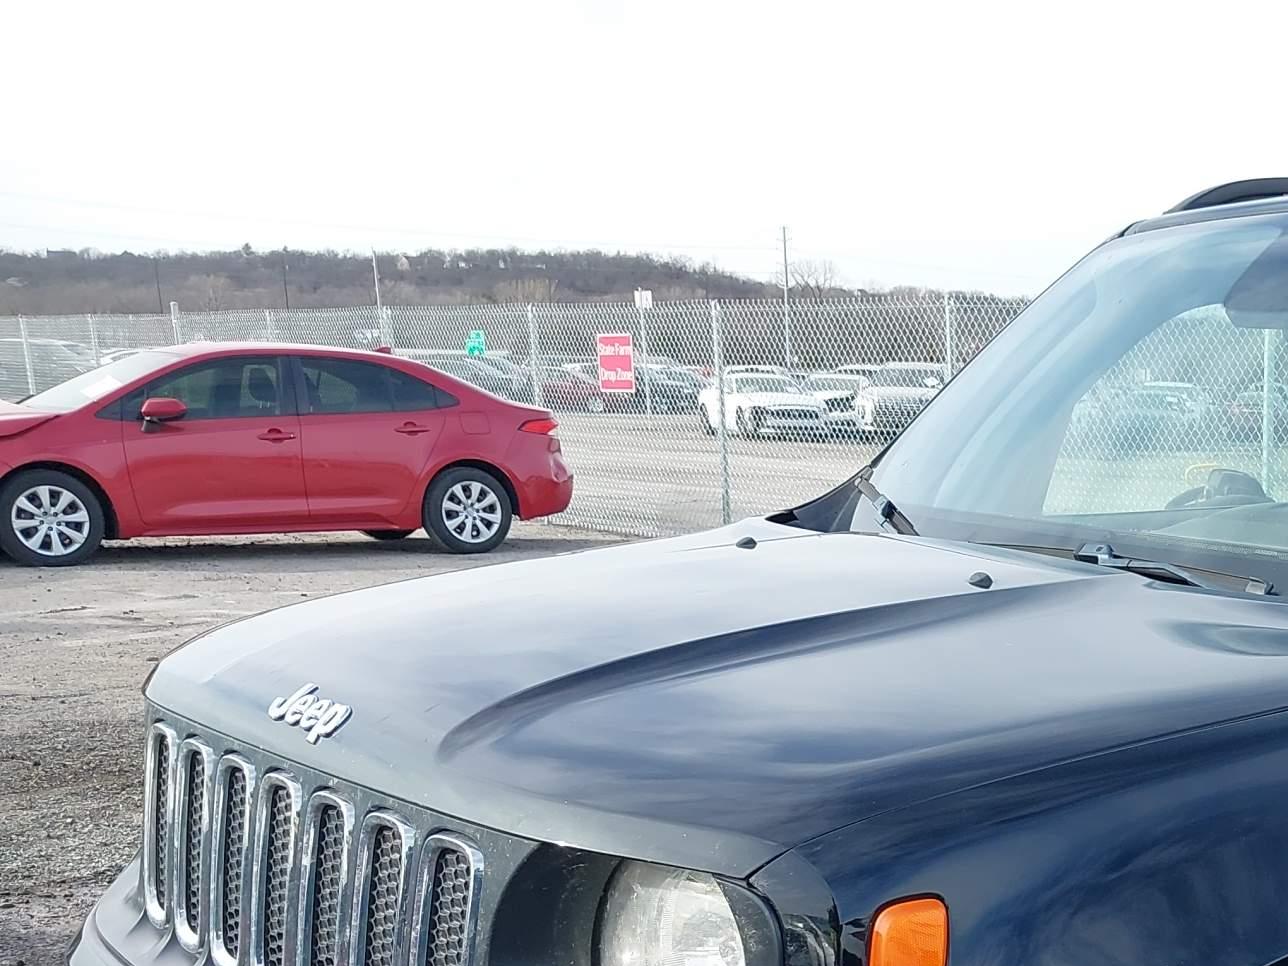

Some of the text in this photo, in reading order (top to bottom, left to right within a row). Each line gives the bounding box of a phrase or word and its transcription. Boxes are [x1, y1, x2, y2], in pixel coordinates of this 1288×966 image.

[599, 343, 632, 355] State Farm
[601, 368, 633, 383] Drop Zone
[268, 682, 353, 746] Jeep
